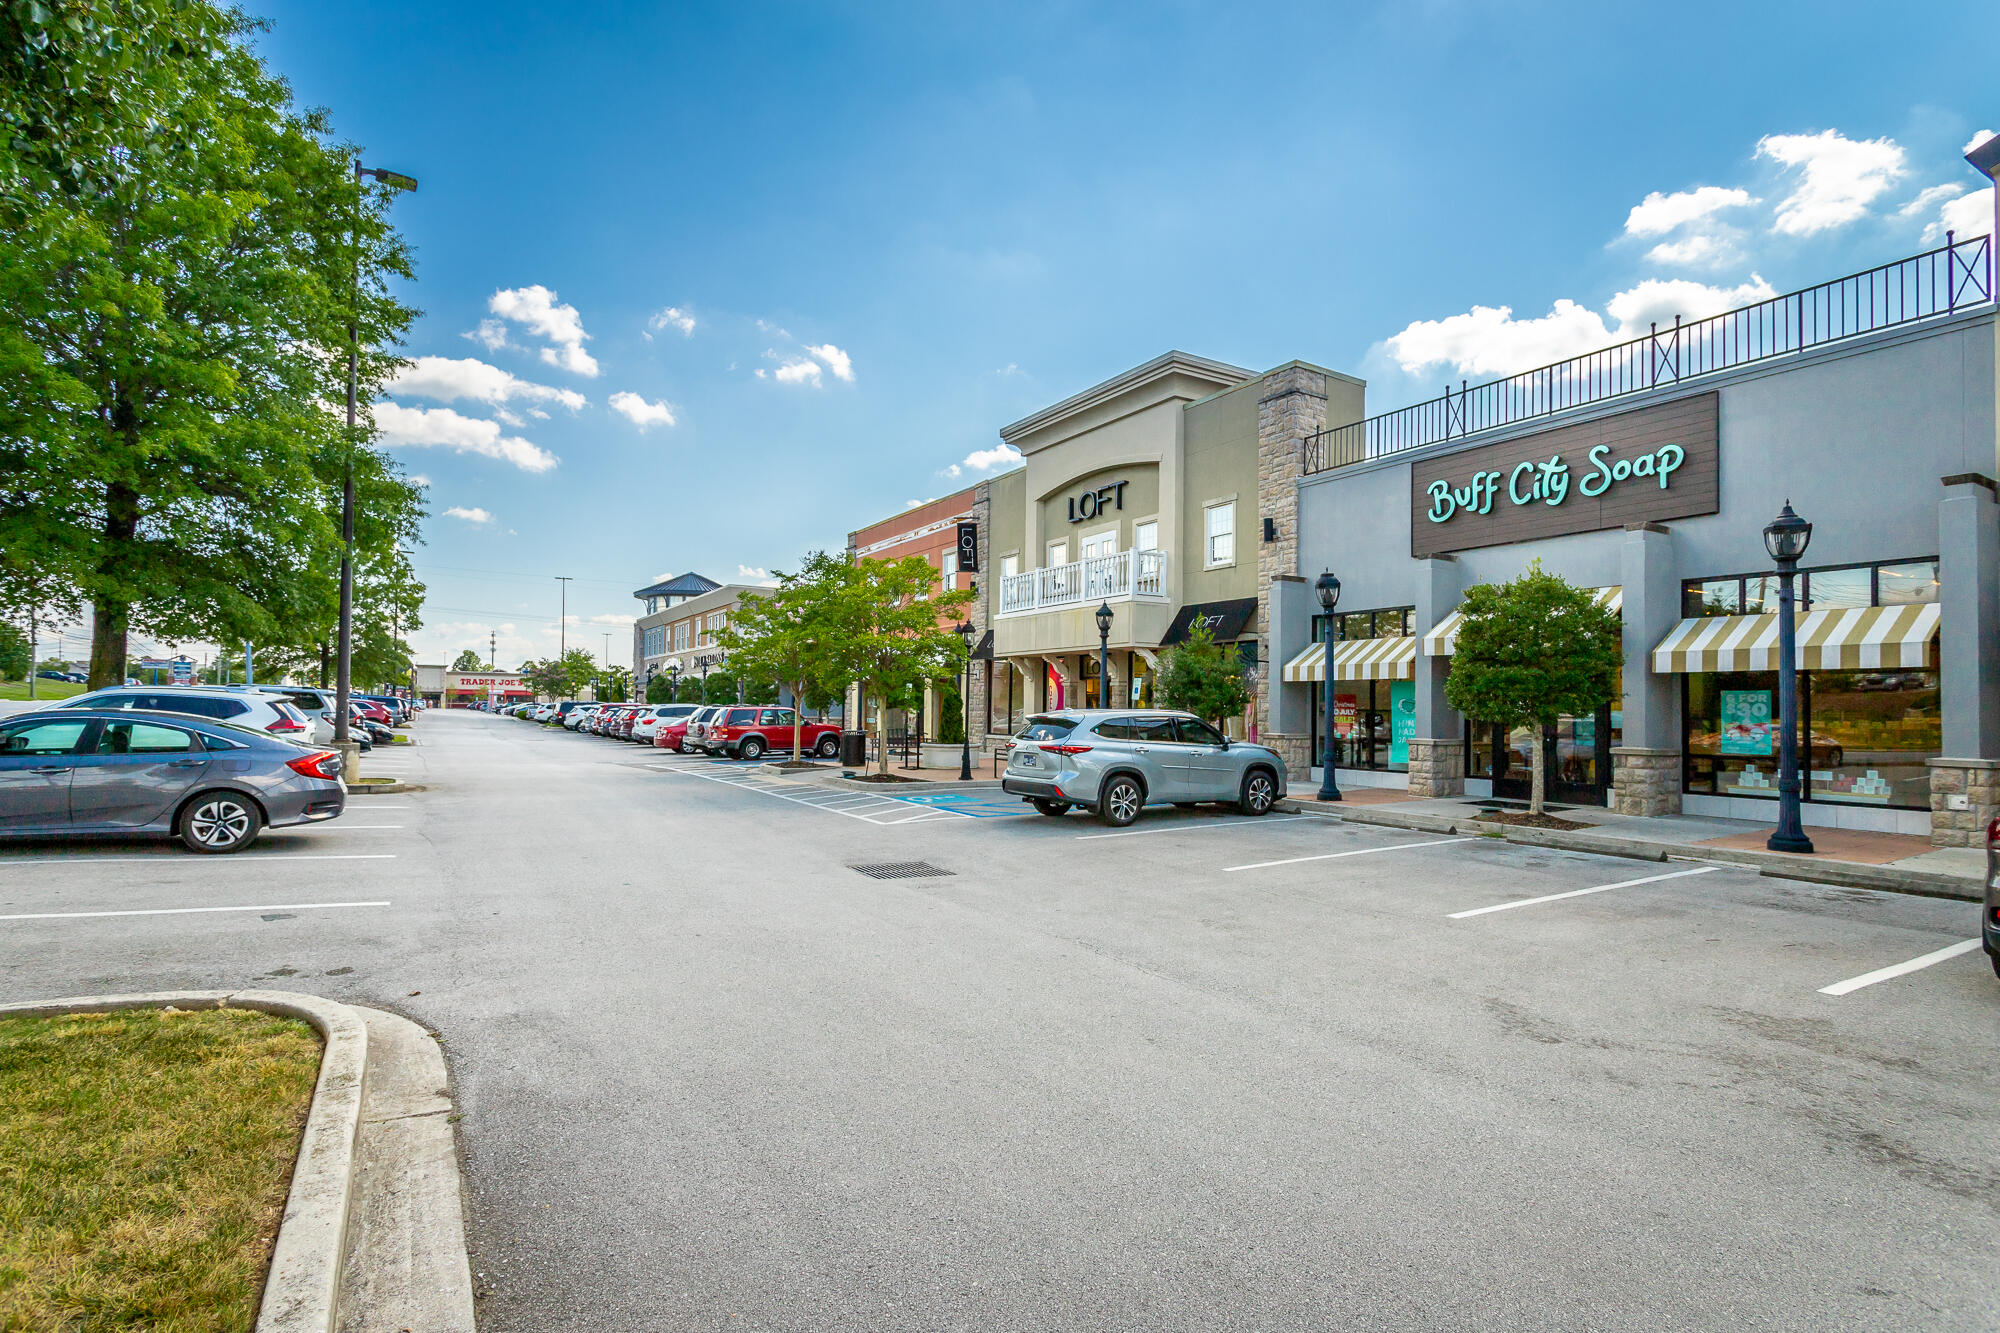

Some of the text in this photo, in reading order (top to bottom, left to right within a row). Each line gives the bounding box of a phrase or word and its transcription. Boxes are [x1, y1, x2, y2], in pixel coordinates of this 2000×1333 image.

[1068, 480, 1130, 523] LOFT
[1427, 444, 1686, 523] Buff City Soap
[962, 528, 975, 568] LOFT
[460, 678, 496, 686] TRADER
[1739, 694, 1767, 702] FOR
